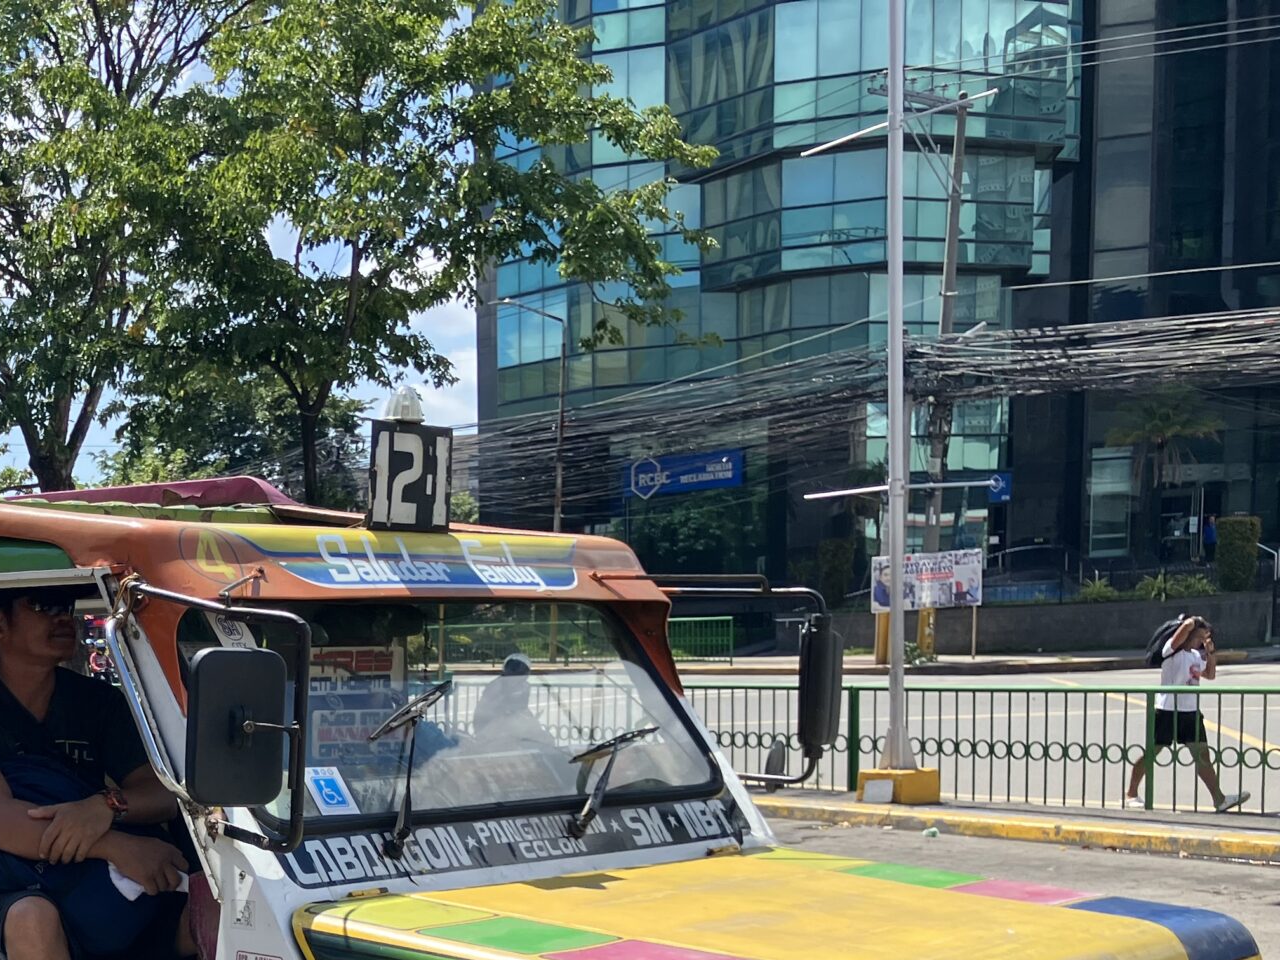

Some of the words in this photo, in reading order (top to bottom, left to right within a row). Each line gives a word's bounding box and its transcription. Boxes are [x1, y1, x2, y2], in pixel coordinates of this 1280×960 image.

[638, 471, 671, 487] RCBC
[680, 470, 733, 484] RECLAMATION
[195, 530, 236, 580] 4
[315, 534, 451, 582] Saludar
[459, 538, 545, 592] Family
[621, 807, 673, 846] SM
[519, 837, 588, 859] COLON
